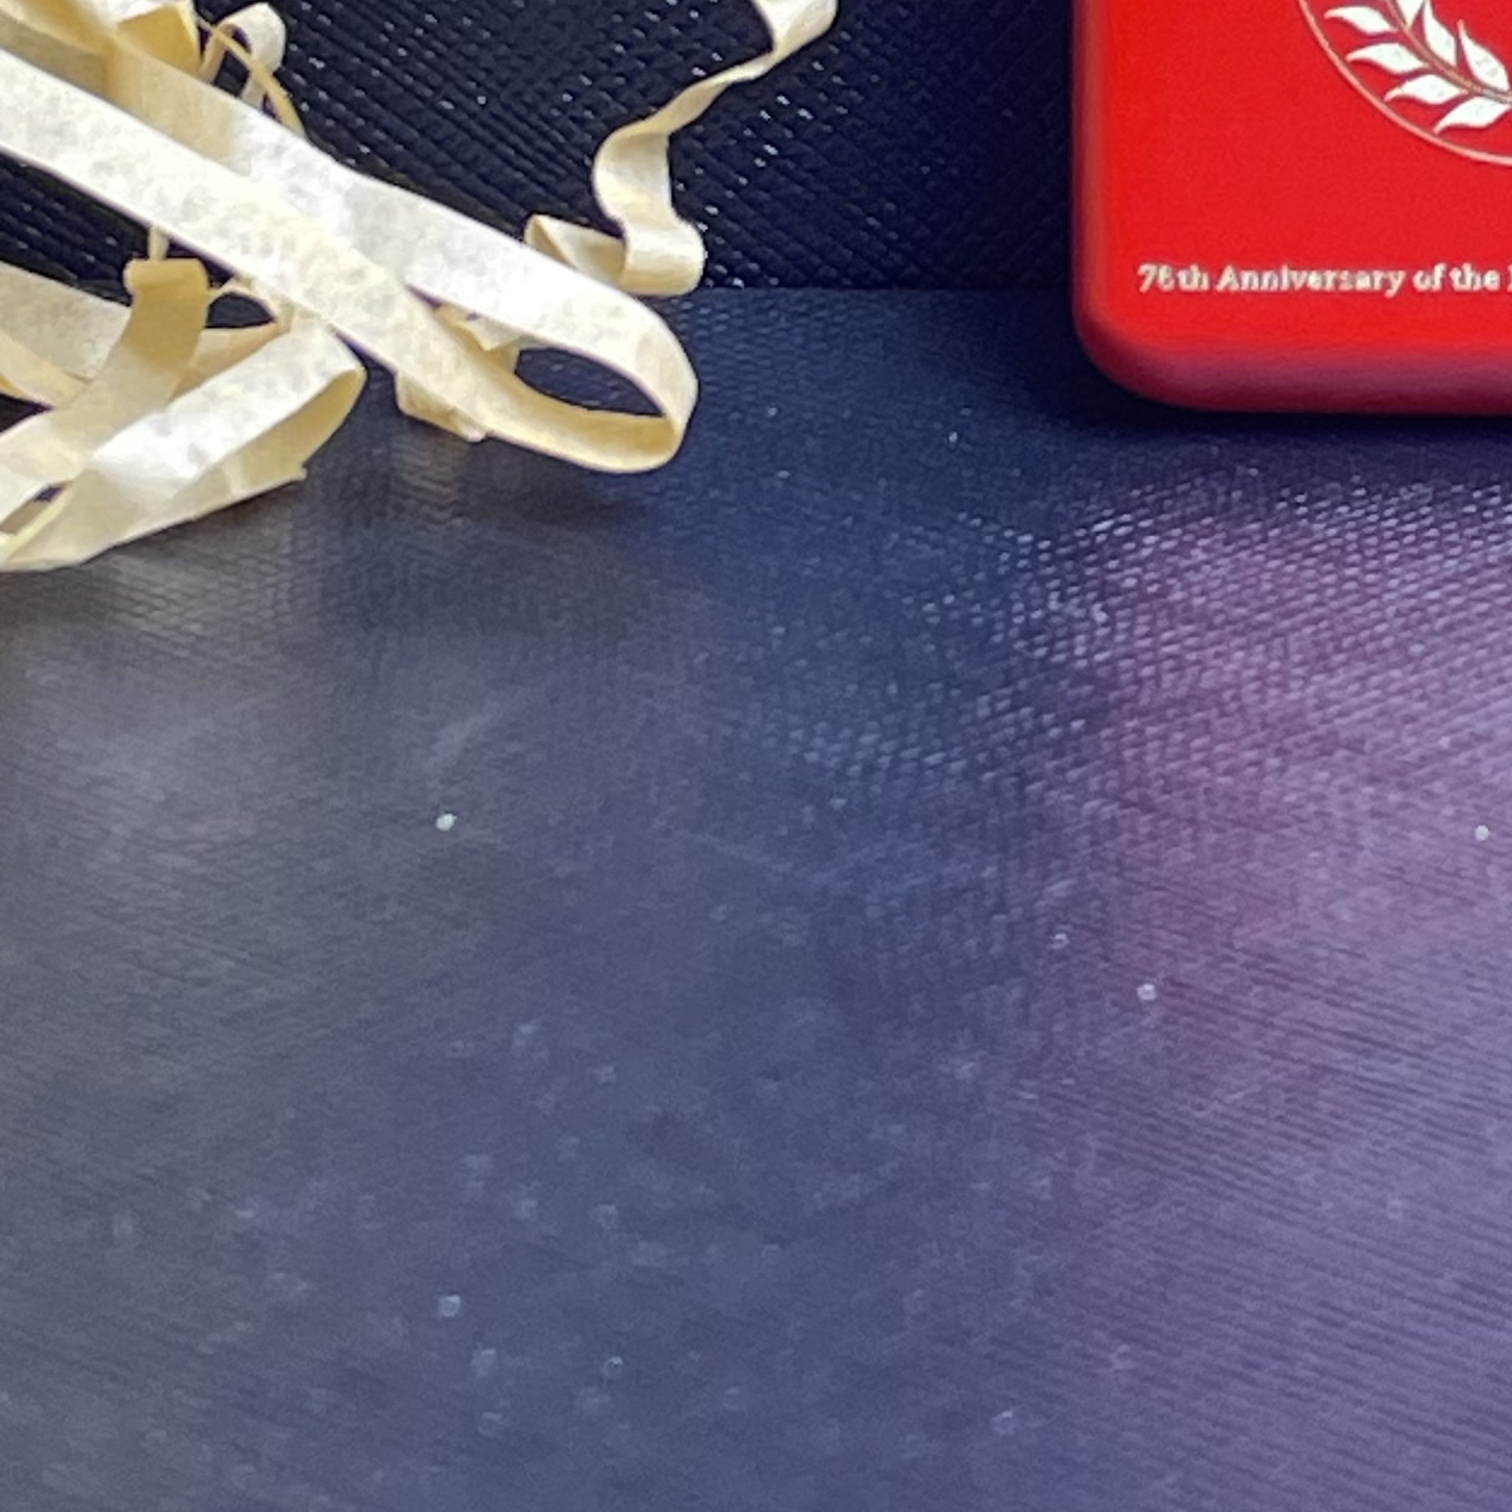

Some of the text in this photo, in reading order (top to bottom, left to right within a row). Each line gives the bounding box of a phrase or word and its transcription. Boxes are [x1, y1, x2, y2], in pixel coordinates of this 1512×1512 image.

[1216, 264, 1405, 298] Anniversary
[1412, 263, 1447, 291] of
[1449, 264, 1499, 291] the
